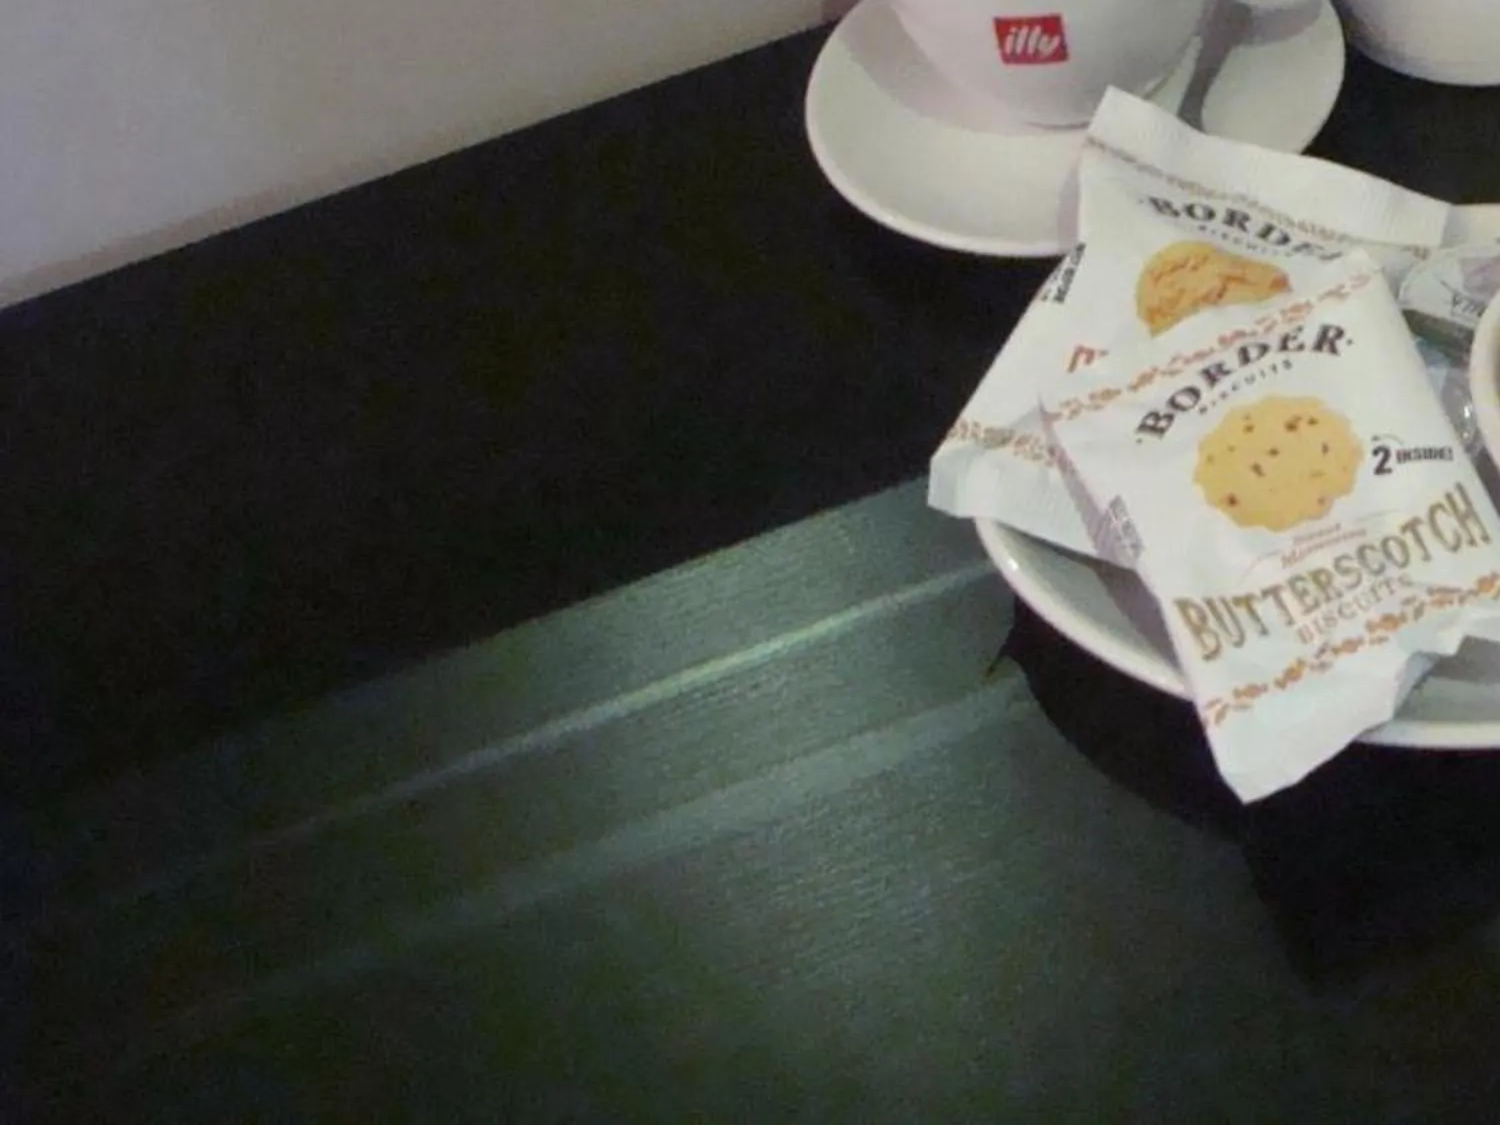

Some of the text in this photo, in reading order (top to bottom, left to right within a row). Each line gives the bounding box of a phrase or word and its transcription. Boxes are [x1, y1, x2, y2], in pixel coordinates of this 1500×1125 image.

[1004, 25, 1060, 58] illy
[1136, 323, 1346, 440] BORDER
[1373, 444, 1393, 475] 2
[1173, 481, 1491, 661] BUTTERSCOTCH
